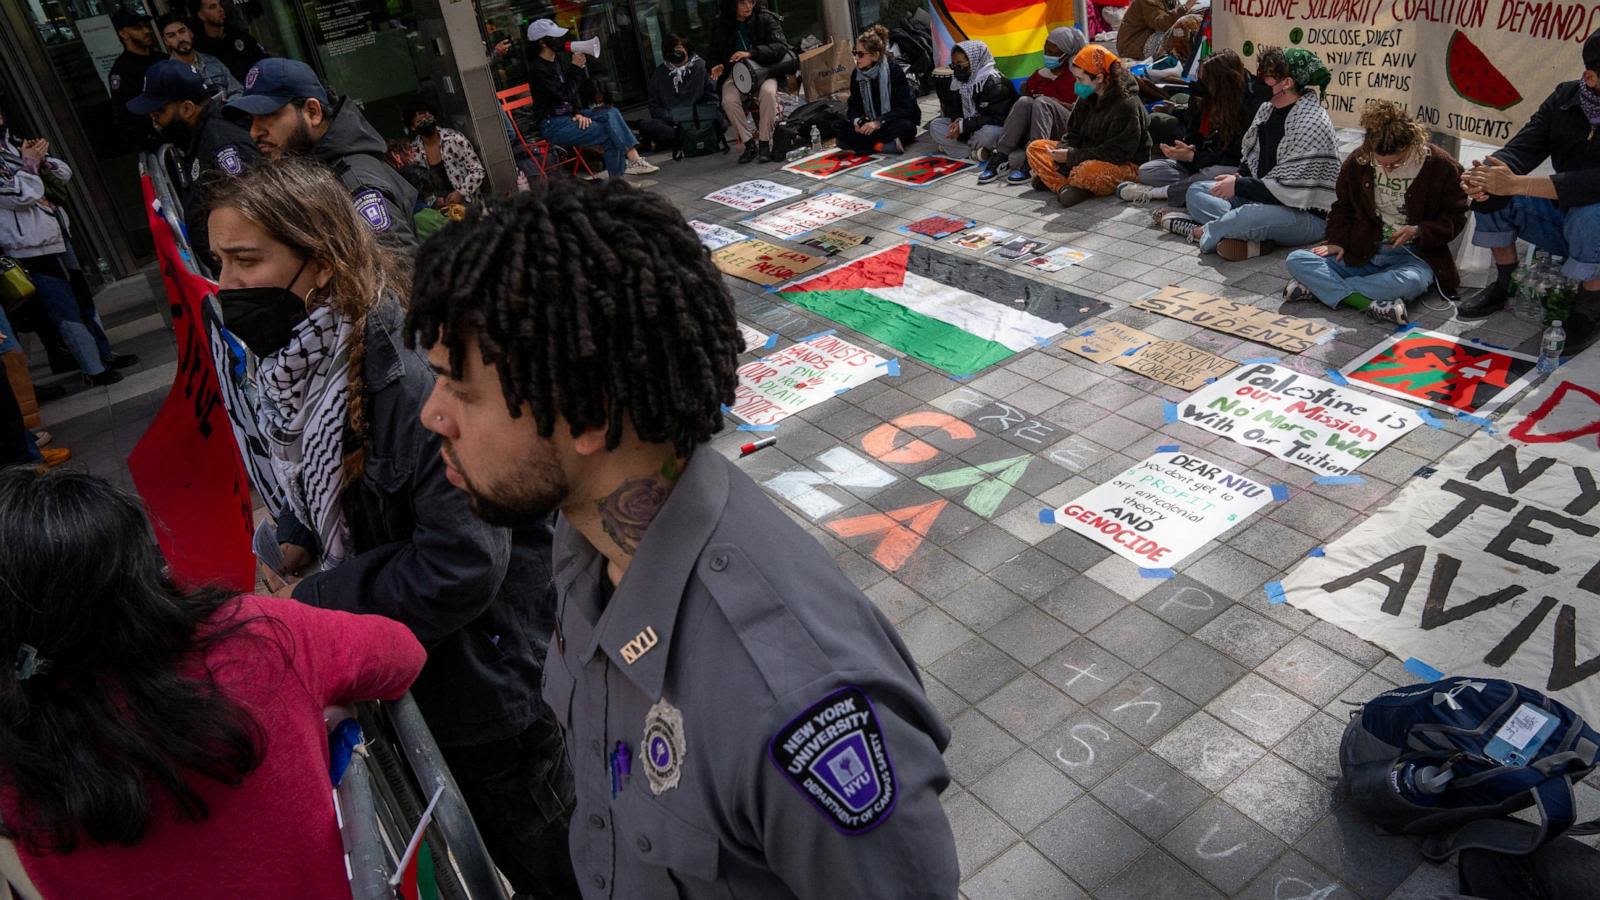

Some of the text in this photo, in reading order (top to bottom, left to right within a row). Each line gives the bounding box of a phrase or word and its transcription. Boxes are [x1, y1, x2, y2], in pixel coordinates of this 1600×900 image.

[1355, 52, 1376, 66] TEL
[1382, 53, 1417, 69] AVIV
[1338, 71, 1412, 92] OFF CAMPUS
[1416, 105, 1440, 125] AND
[1446, 112, 1513, 140] STUDENTS
[1138, 298, 1315, 351] STUDENTS
[1169, 289, 1328, 337] LISTEN
[735, 362, 778, 384] OUR
[1129, 358, 1195, 386] FOREVER
[1149, 340, 1232, 374] PALESTINE
[1234, 364, 1407, 430] Palestine is
[1252, 410, 1319, 441] More
[1284, 401, 1378, 442] Mission
[1283, 439, 1350, 476] Tuition
[1138, 474, 1217, 512] PROFIT
[1168, 454, 1266, 499] DEAR NYU
[1189, 481, 1217, 495] get
[1220, 491, 1234, 502] to
[1103, 506, 1155, 533] AND
[1122, 495, 1170, 522] theory
[1063, 503, 1173, 562] GENOCIDE
[619, 625, 658, 665] NYU
[783, 697, 857, 755] NEW YORK
[787, 710, 870, 774] UNIVERSITY
[802, 777, 860, 827] DEPARTMENT
[860, 809, 875, 824] OF
[843, 771, 871, 798] NYU
